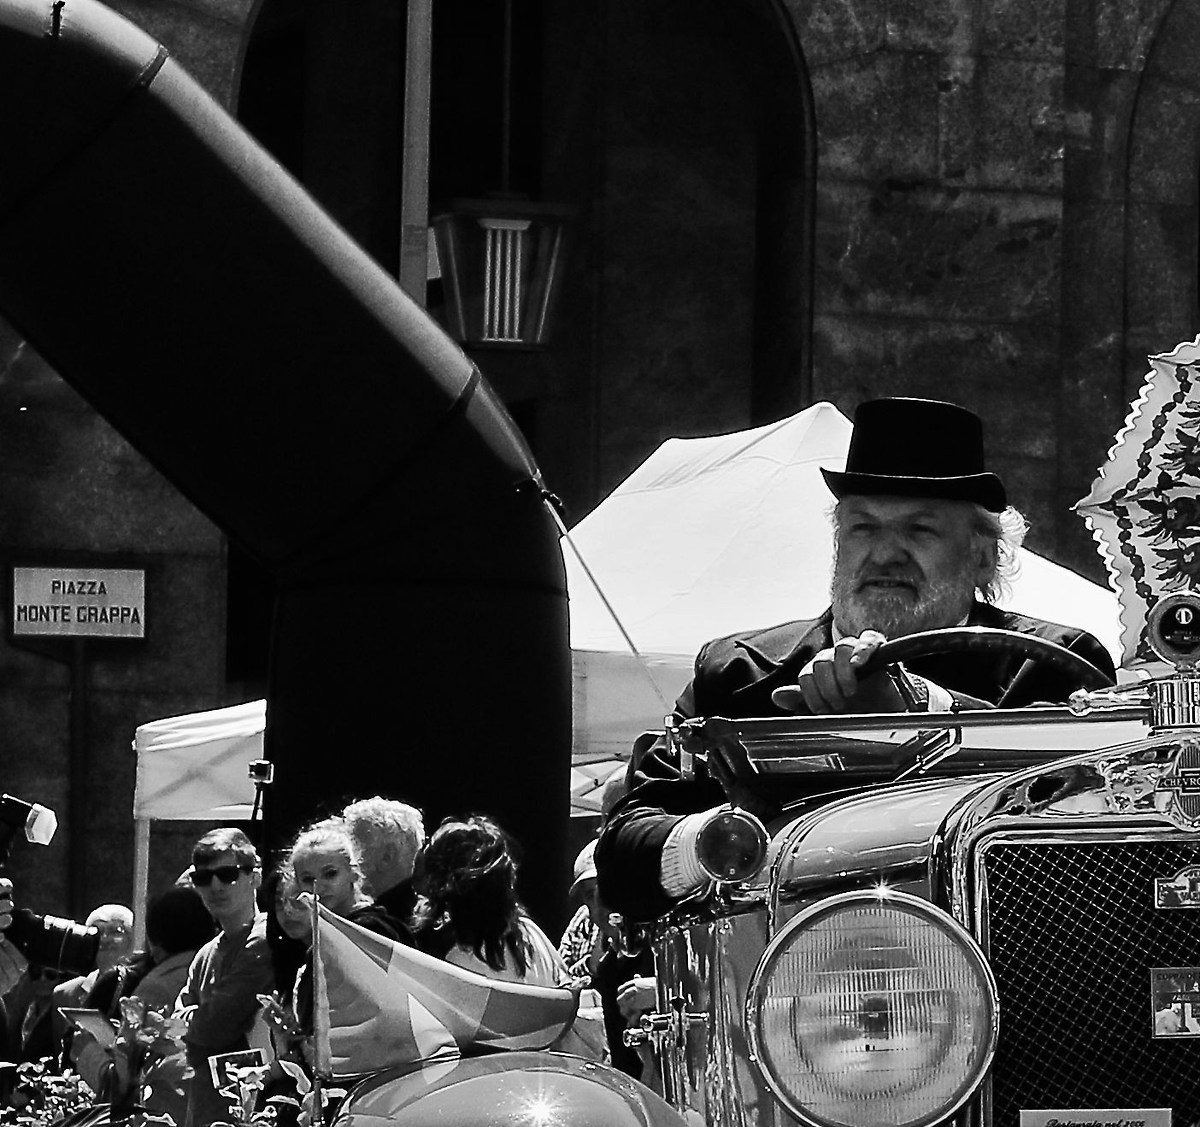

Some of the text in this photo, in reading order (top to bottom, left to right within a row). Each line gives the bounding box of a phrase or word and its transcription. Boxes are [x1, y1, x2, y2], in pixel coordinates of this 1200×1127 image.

[51, 580, 107, 595] PIAZZA
[16, 605, 140, 624] MONTE GRAPPA
